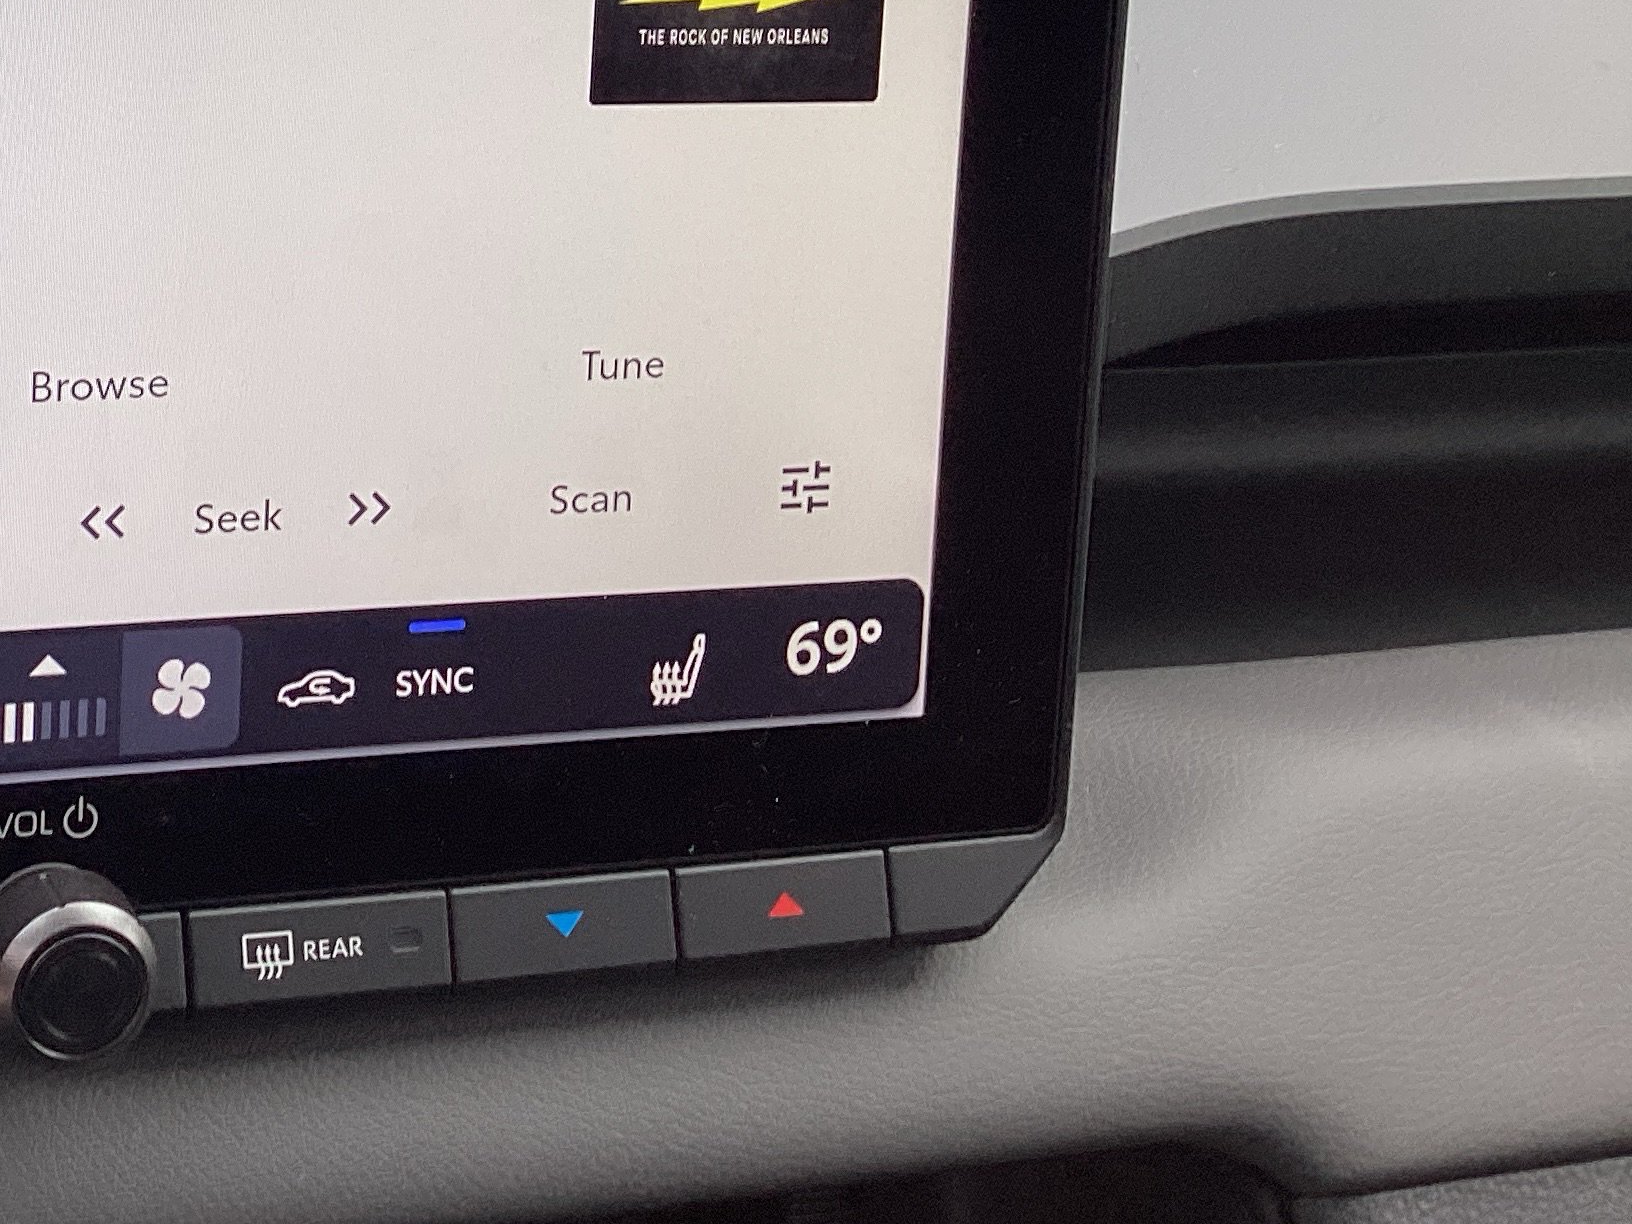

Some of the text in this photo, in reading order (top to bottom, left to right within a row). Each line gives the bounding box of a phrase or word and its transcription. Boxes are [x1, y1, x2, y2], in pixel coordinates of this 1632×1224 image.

[639, 29, 829, 46] THE ROCK OF NEW ORLEANS
[583, 351, 664, 380] Tune
[32, 371, 168, 402] Browse
[551, 485, 631, 514] Scan
[195, 499, 281, 534] Seek
[396, 667, 473, 697] SYNC
[304, 937, 362, 960] REAR
